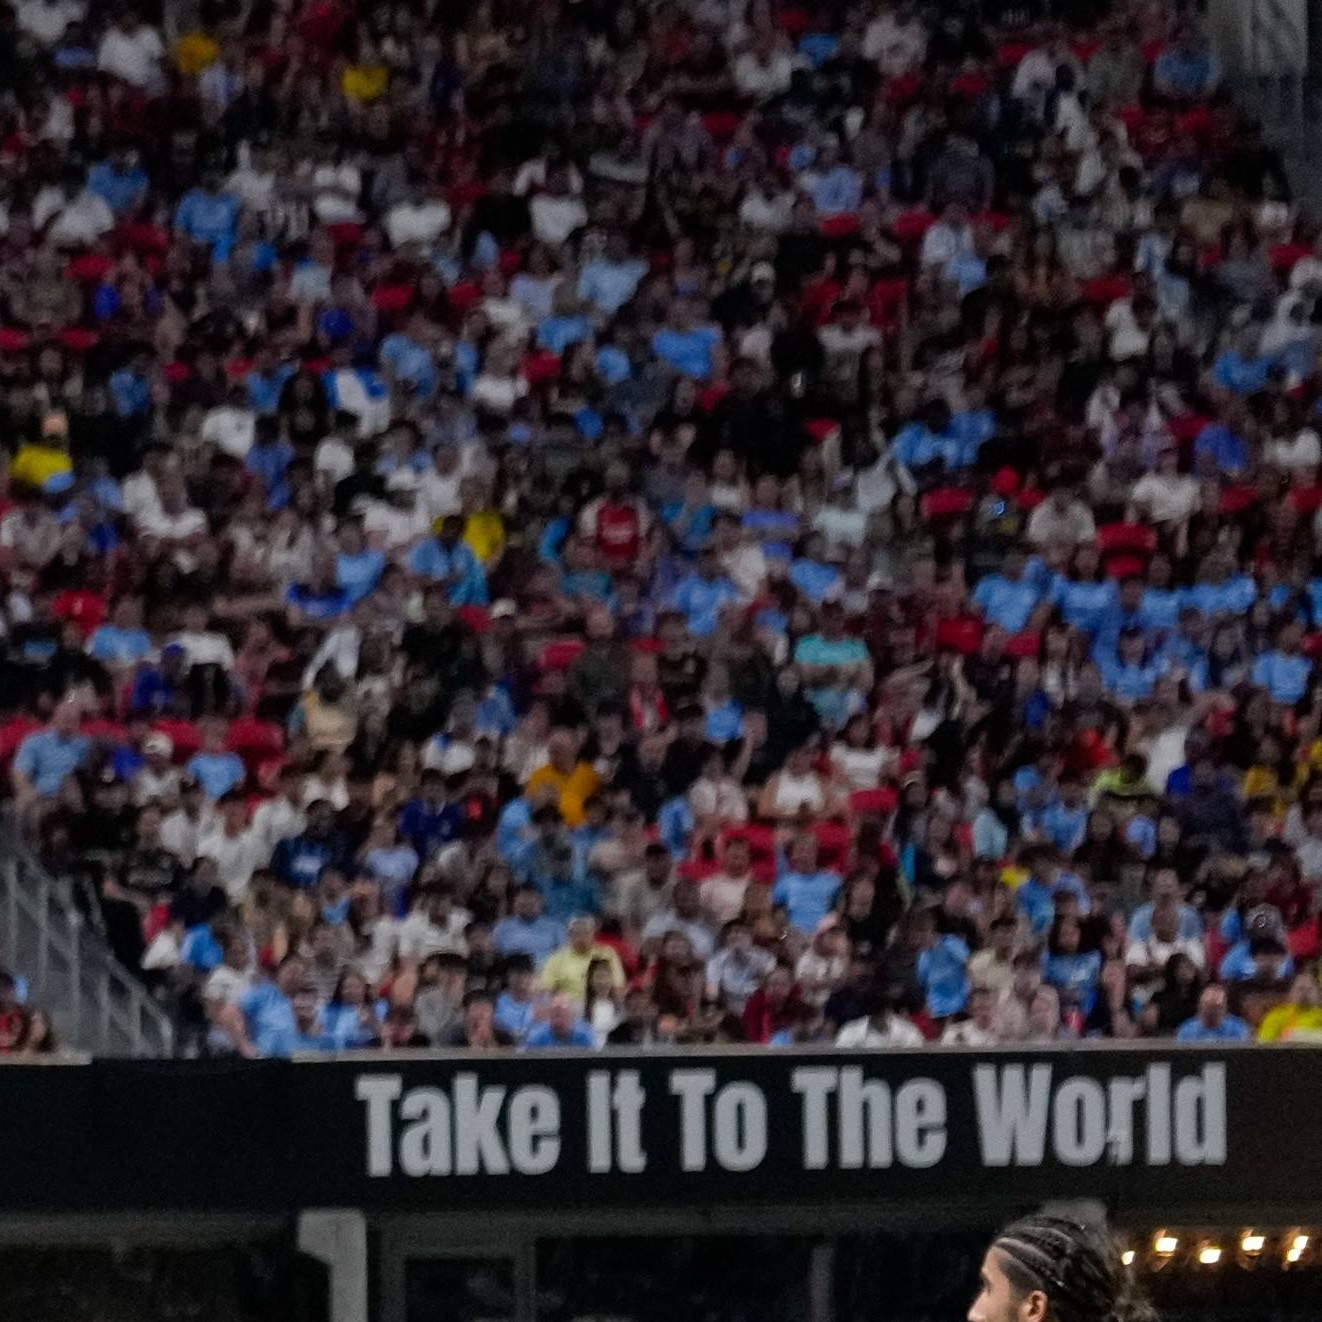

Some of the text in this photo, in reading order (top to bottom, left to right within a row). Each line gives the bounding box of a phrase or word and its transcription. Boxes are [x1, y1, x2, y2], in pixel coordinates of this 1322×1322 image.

[357, 1062, 1226, 1177] Take It To The World
